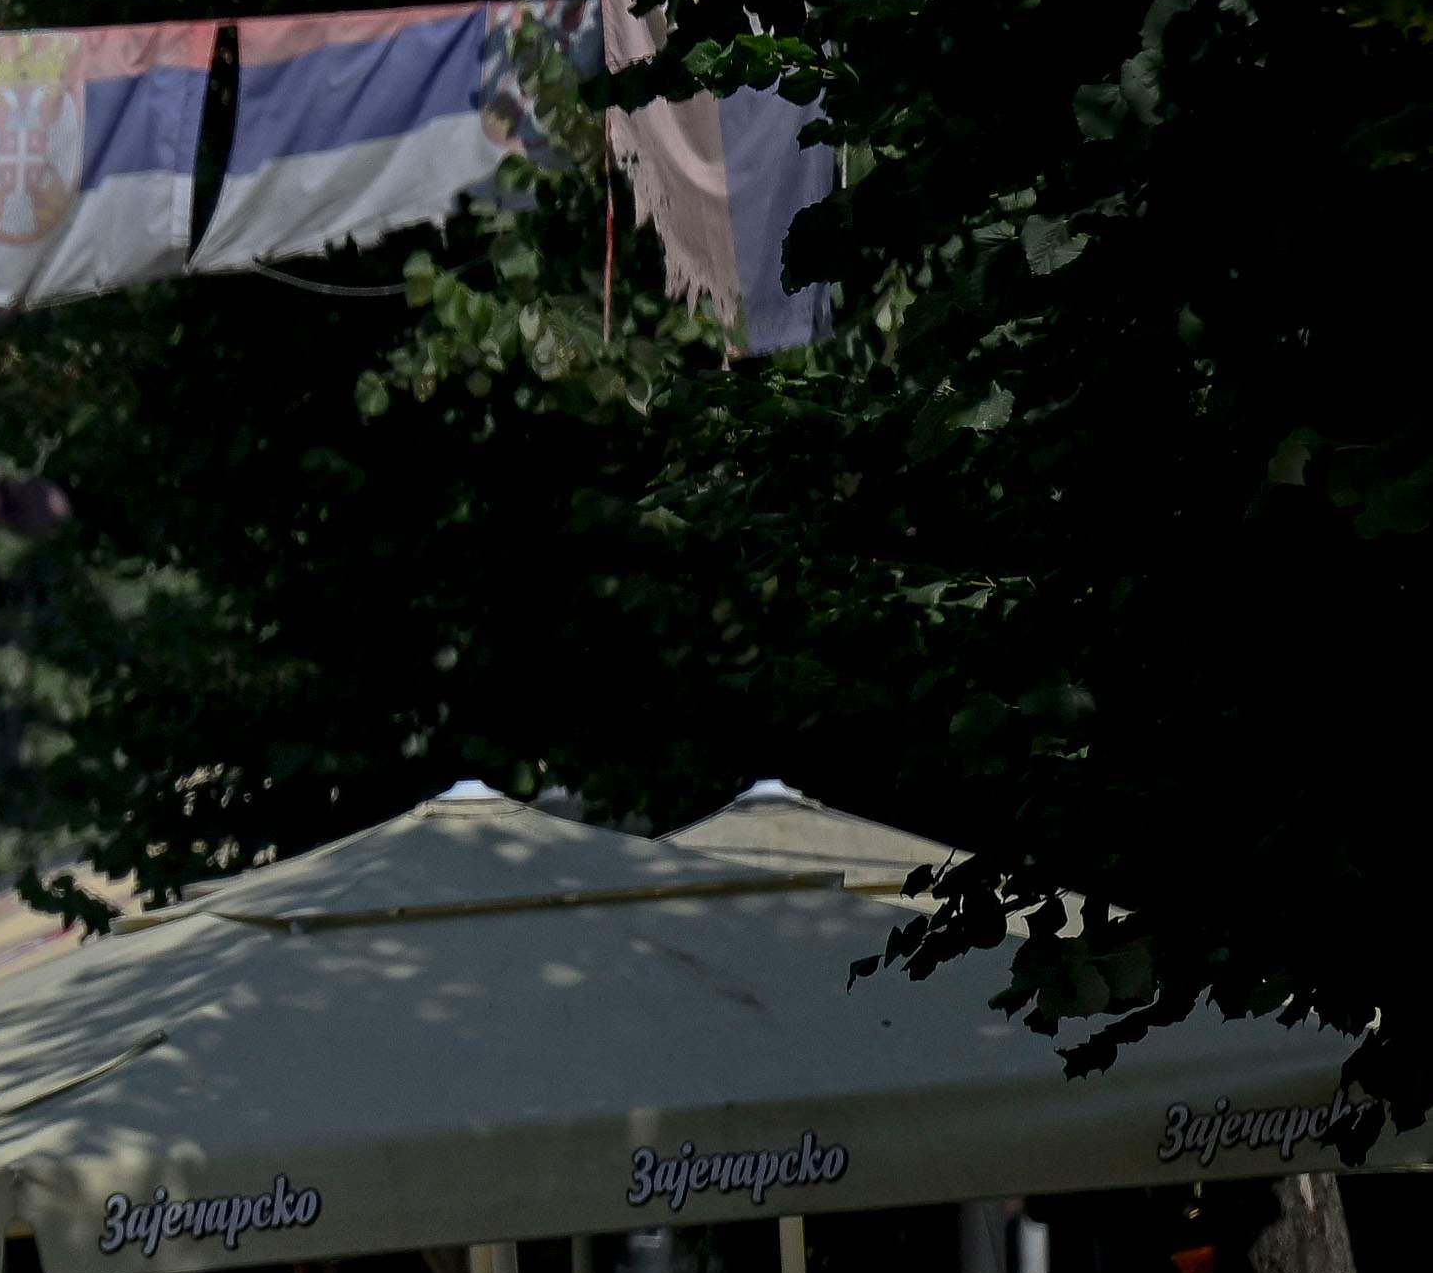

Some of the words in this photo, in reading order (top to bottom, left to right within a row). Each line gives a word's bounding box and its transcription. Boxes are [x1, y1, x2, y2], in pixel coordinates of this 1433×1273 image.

[1158, 1088, 1381, 1166] Зајечарск
[627, 1128, 848, 1211] Зајечарско
[100, 1174, 321, 1256] Зајечарско
